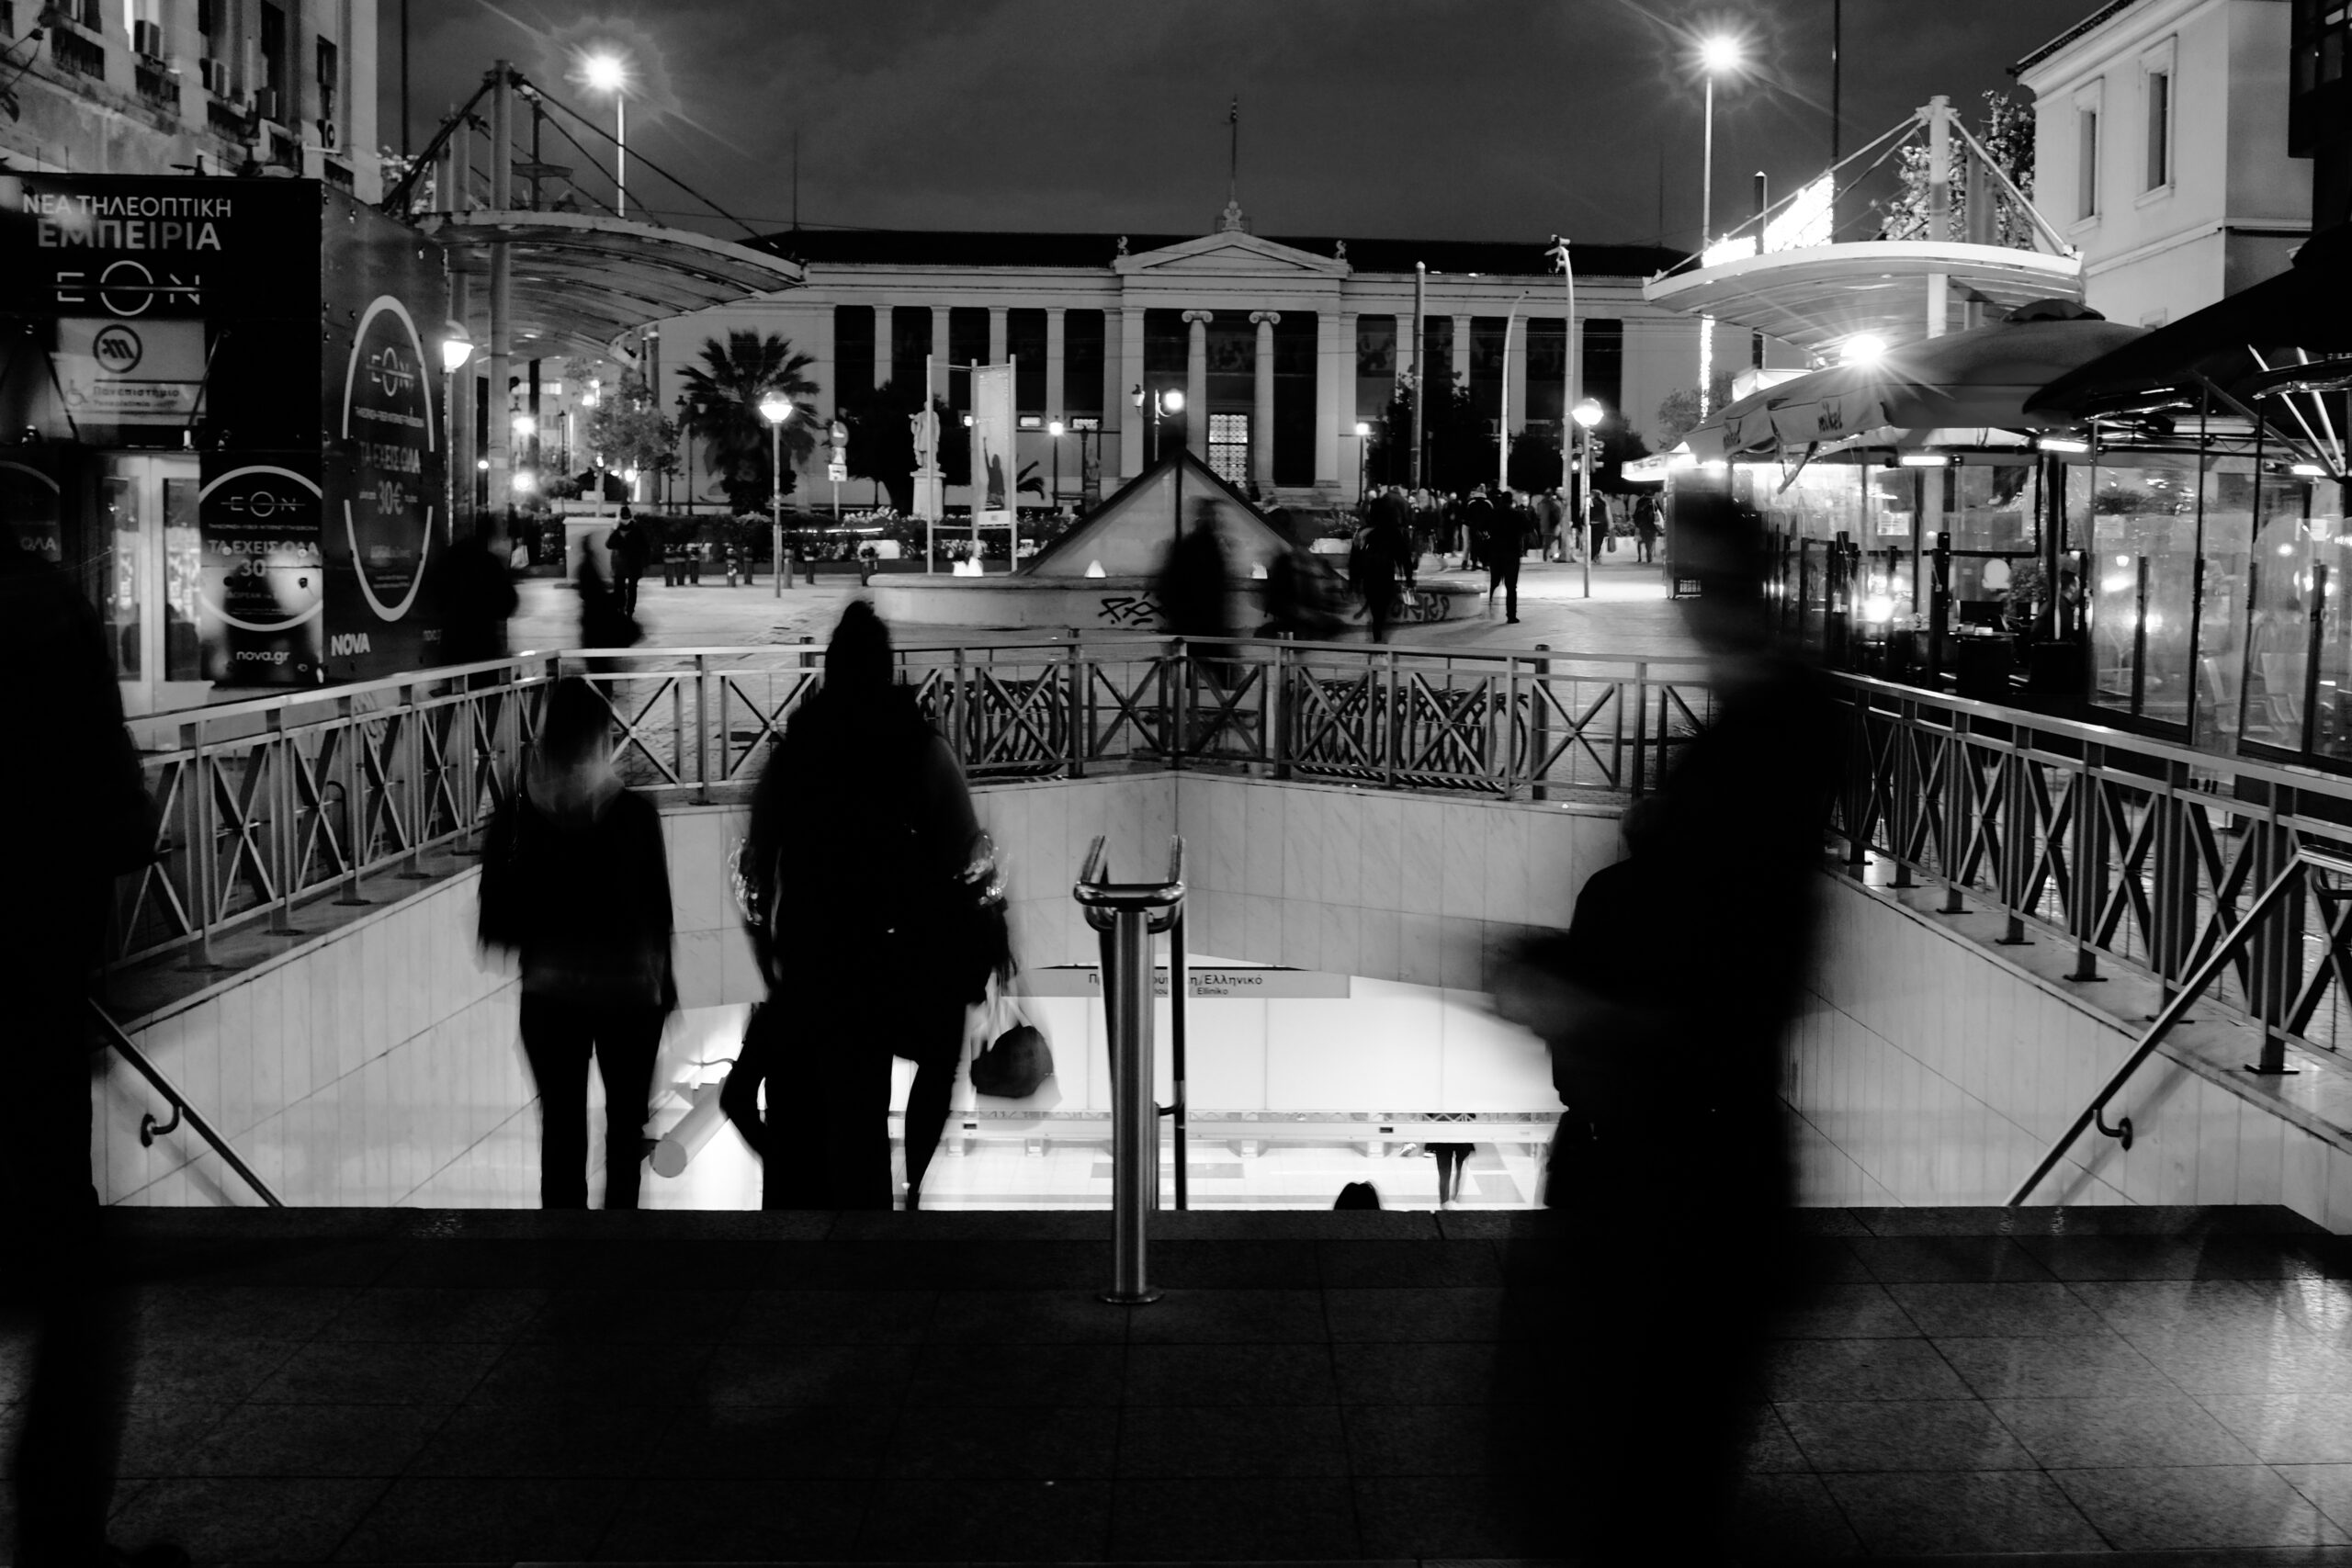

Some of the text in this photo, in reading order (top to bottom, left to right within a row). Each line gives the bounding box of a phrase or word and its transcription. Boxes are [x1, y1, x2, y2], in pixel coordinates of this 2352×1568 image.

[23, 194, 232, 218] ΝΕΑ ΤΗΛΕΟΠΤΙΚΗ
[38, 218, 221, 251] ΕΜΠΕΙΡΙΑ
[56, 259, 201, 316] EON
[229, 491, 297, 517] EON
[378, 480, 404, 515] 30€
[208, 539, 231, 555] ΤΑ
[232, 540, 278, 556] ΕΧΕΙΣ
[236, 649, 289, 664] nova.gr
[331, 633, 370, 656] NOVA
